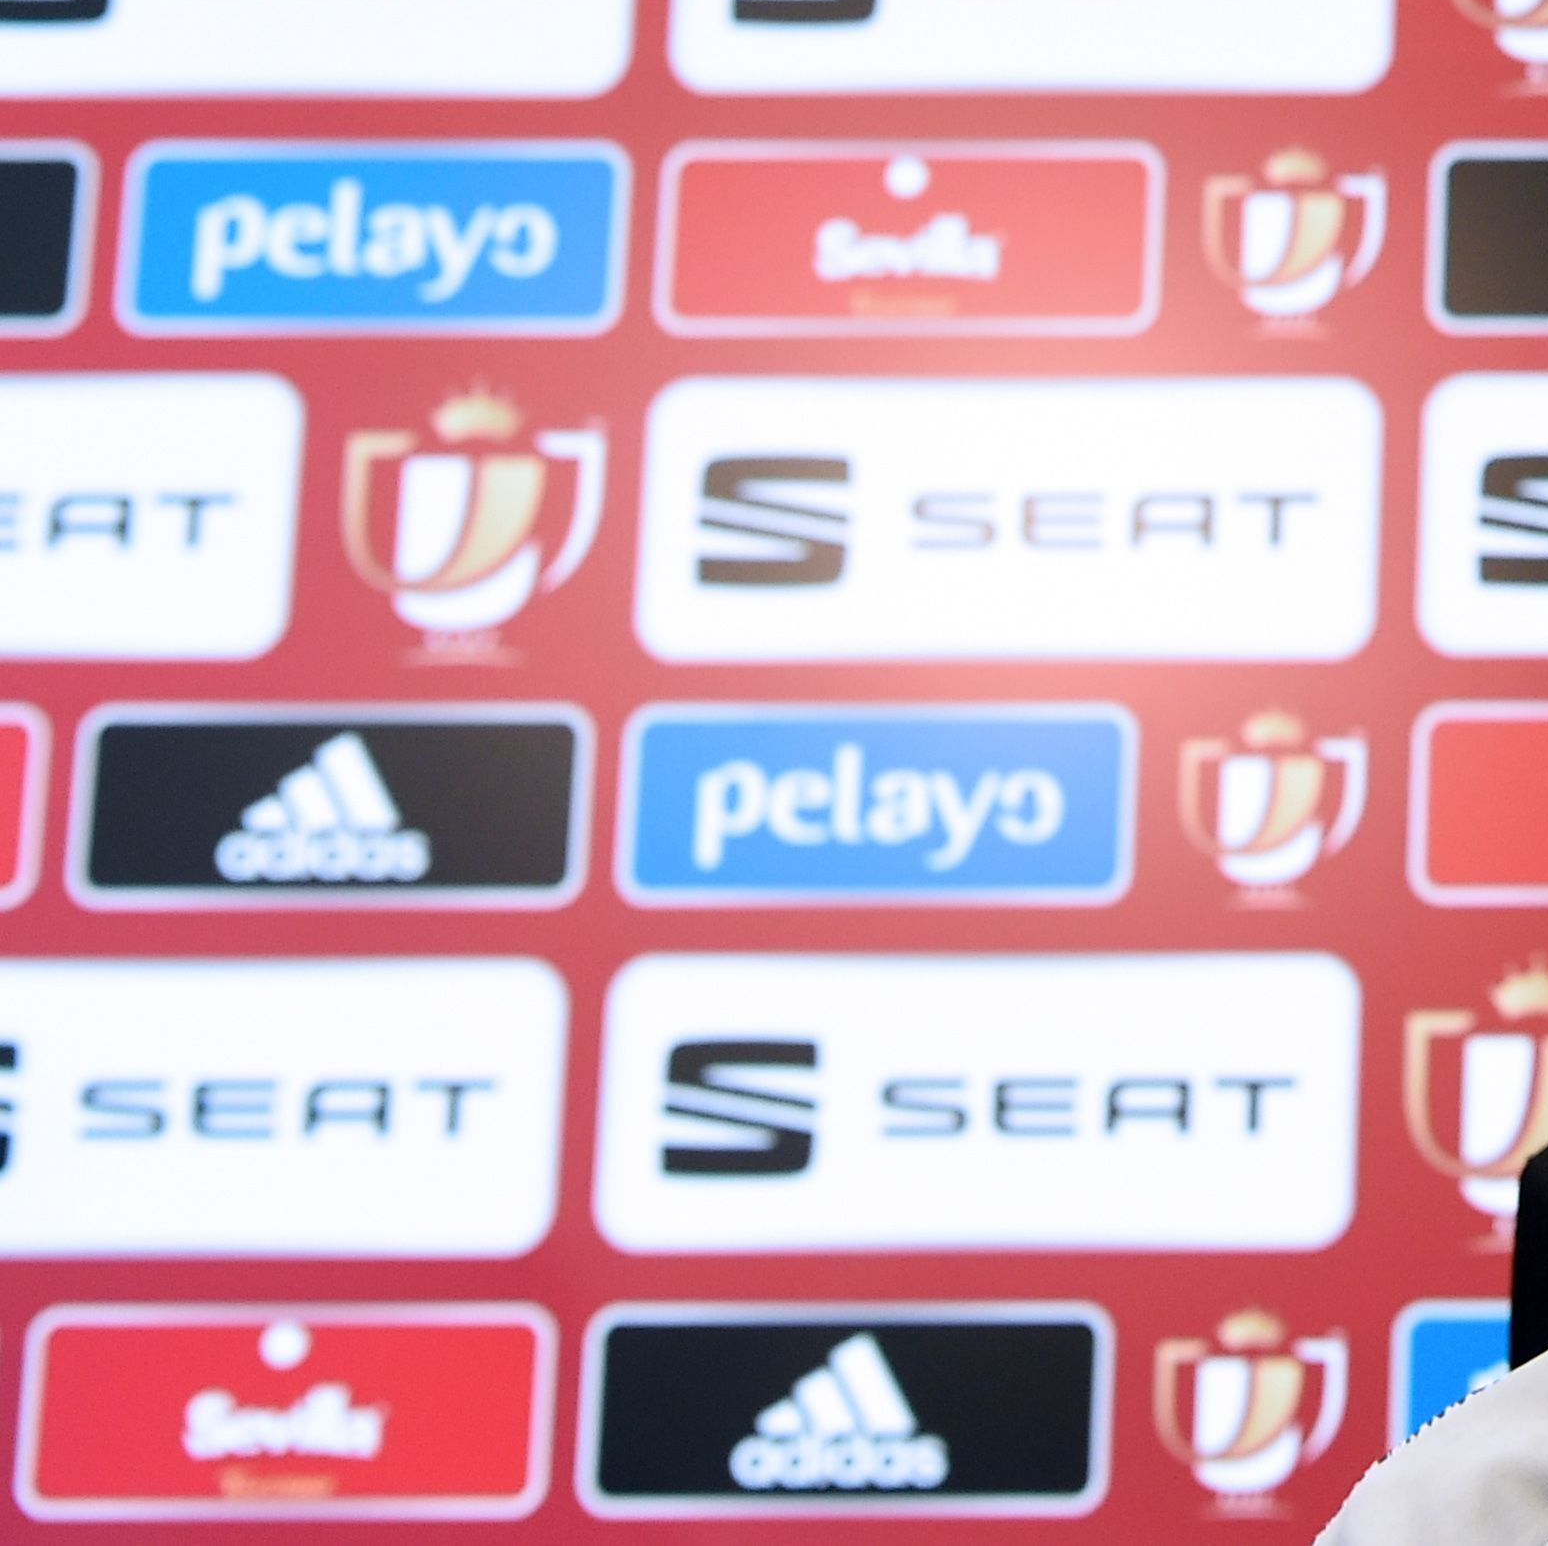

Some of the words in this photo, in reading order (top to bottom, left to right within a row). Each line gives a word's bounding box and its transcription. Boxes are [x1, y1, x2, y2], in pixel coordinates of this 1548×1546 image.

[192, 180, 558, 301] pelayo
[0, 492, 234, 552] AT
[909, 490, 1320, 550] SEAT
[695, 743, 1064, 869] pelayo
[216, 826, 429, 880] adidas
[78, 1079, 494, 1140] SEAT
[879, 1077, 1295, 1137] SEAT
[731, 1431, 946, 1487] adidas
